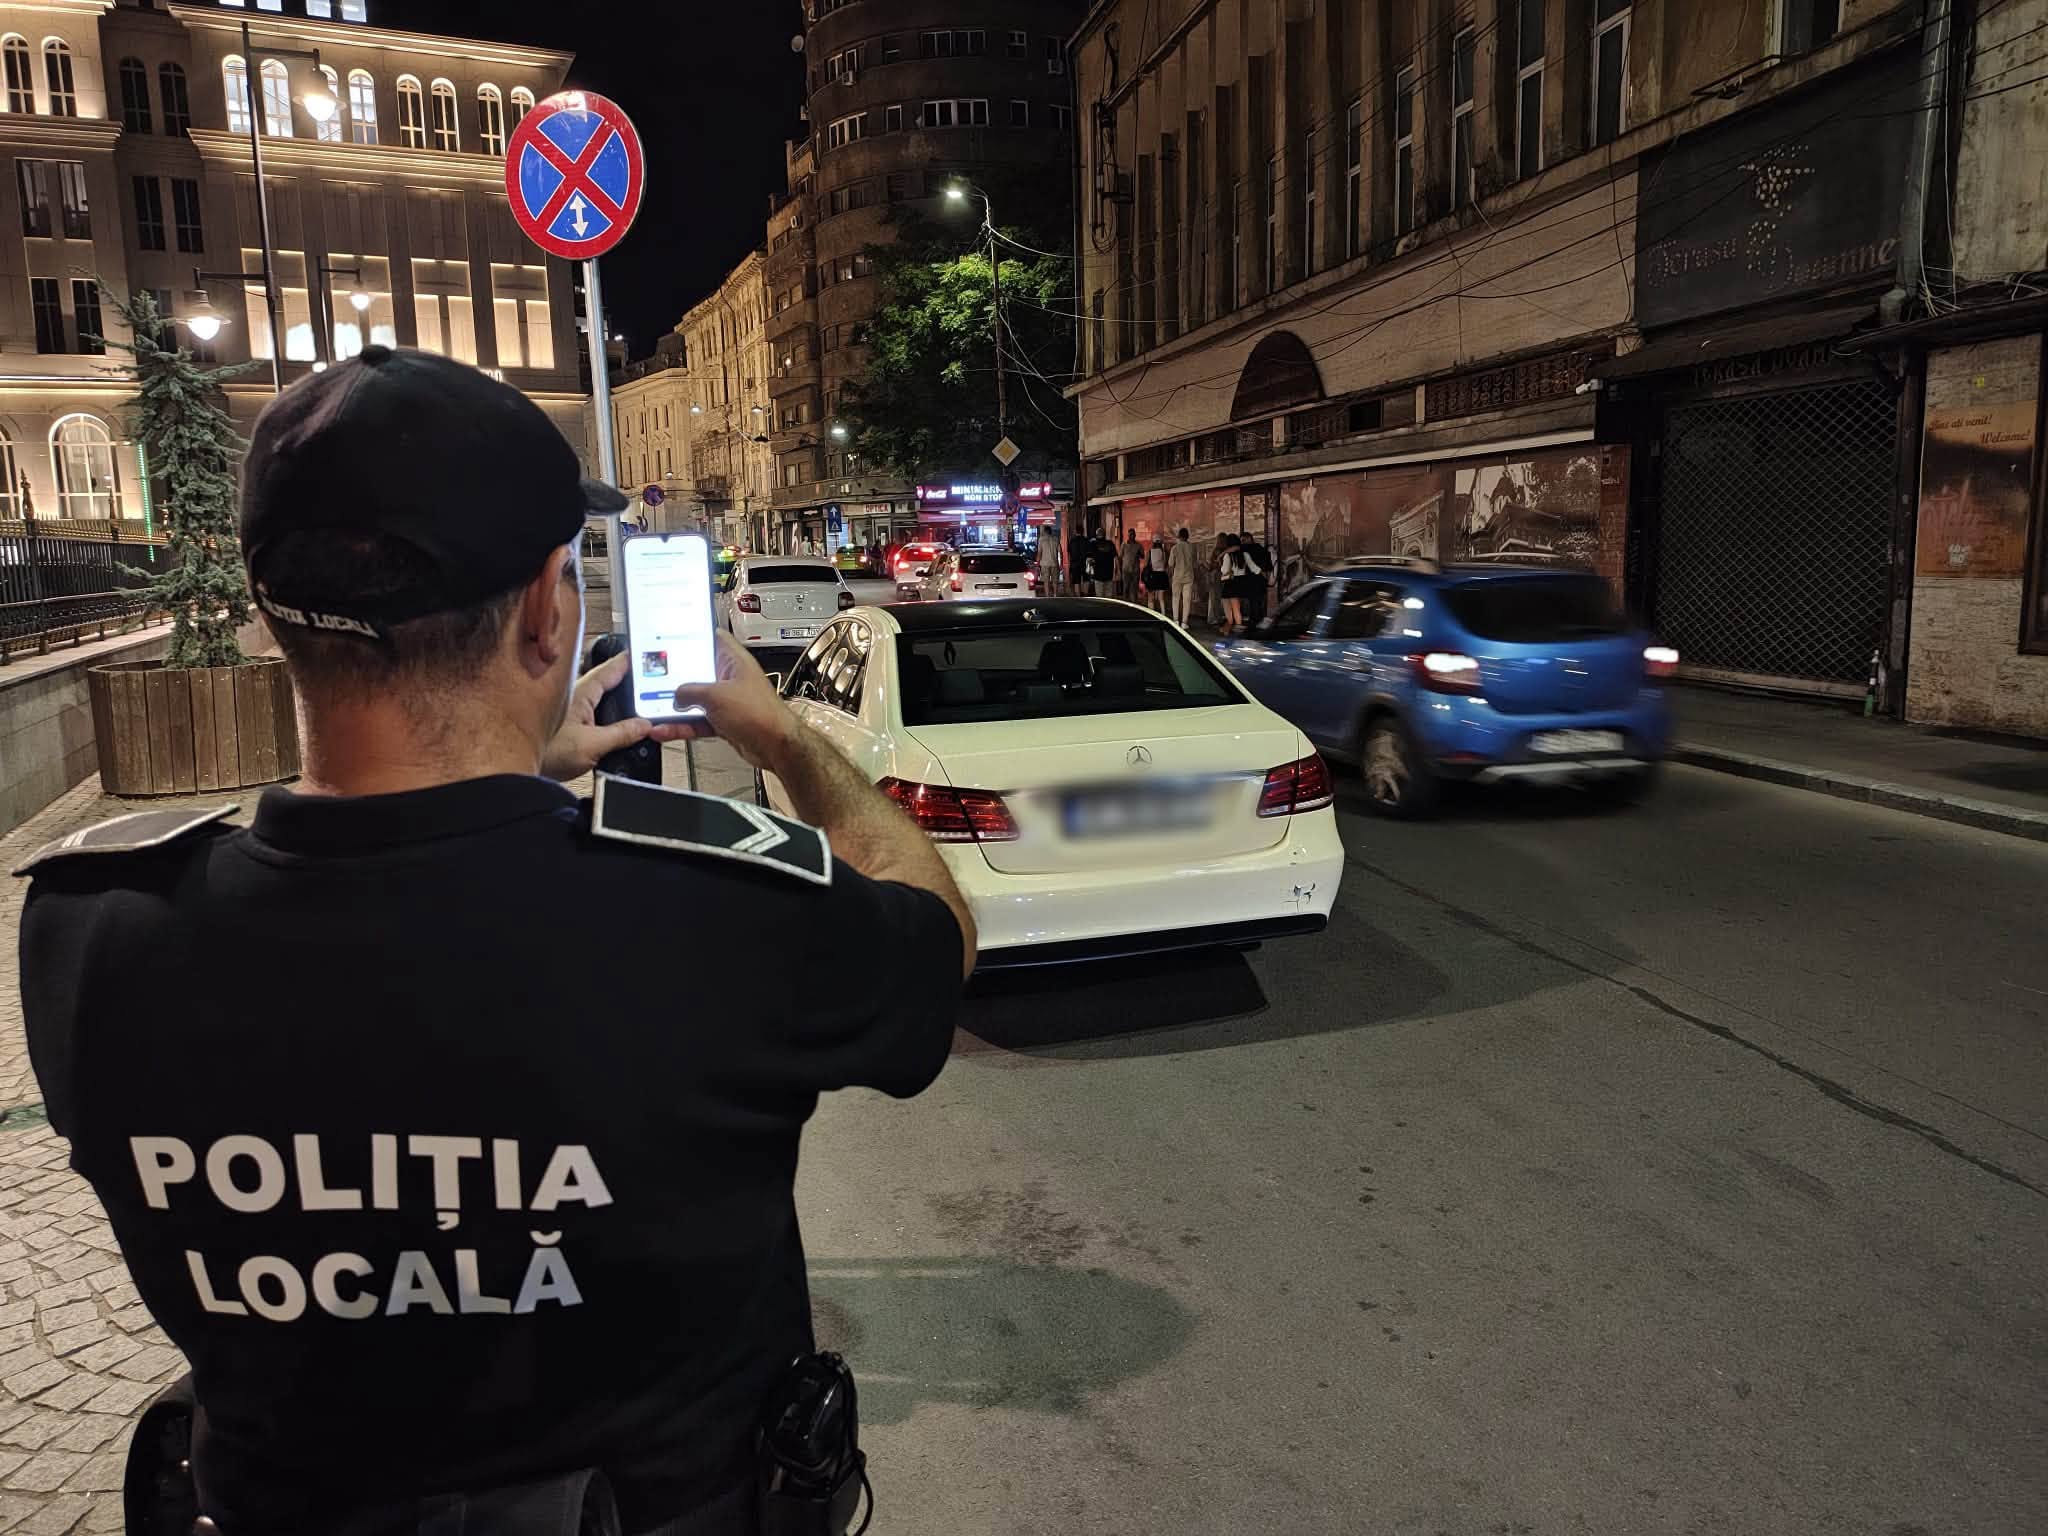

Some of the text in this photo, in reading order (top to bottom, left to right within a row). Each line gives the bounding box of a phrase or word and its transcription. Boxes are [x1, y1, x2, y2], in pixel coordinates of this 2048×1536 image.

[1979, 428, 2032, 444] Welcome!
[865, 503, 888, 512] OPTICA
[129, 1134, 614, 1230] POLIȚIA
[185, 1230, 584, 1322] LOCALĂ
